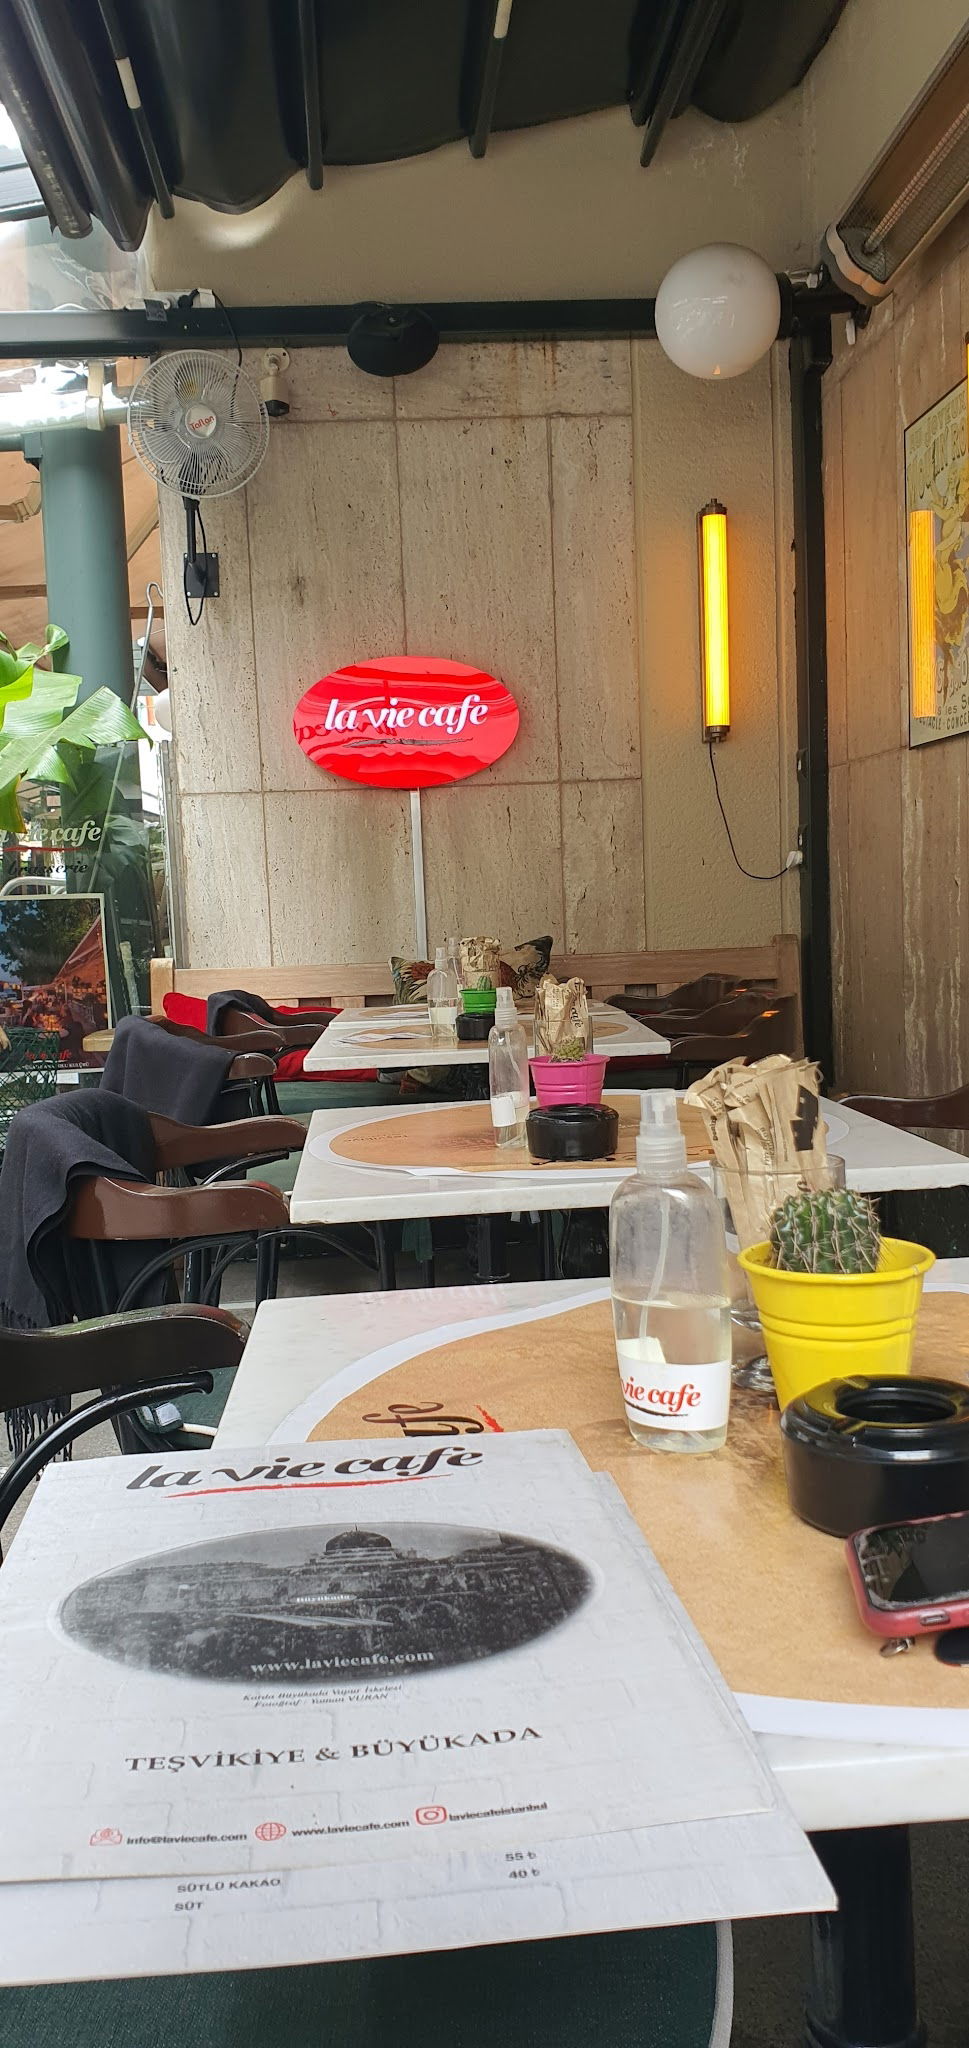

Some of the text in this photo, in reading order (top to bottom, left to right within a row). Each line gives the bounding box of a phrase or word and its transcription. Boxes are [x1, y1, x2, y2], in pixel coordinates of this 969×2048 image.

[188, 415, 215, 430] Taflan
[324, 698, 360, 731] la
[362, 697, 415, 729] vie
[417, 693, 489, 735] cafe
[49, 819, 102, 847] cafe
[621, 1376, 701, 1413] vie cafe
[126, 1446, 484, 1491] la vie cafe
[250, 1651, 435, 1674] www.laviecafe.com
[124, 1726, 543, 1773] TEŞVİKİYE & BÜYÜKADA
[291, 1820, 410, 1837] www.laviecafe.com
[174, 1900, 204, 1912] SÜT
[508, 1869, 528, 1880] 40
[177, 1880, 225, 1894] SÜTLÜ
[228, 1877, 281, 1890] KAKAO
